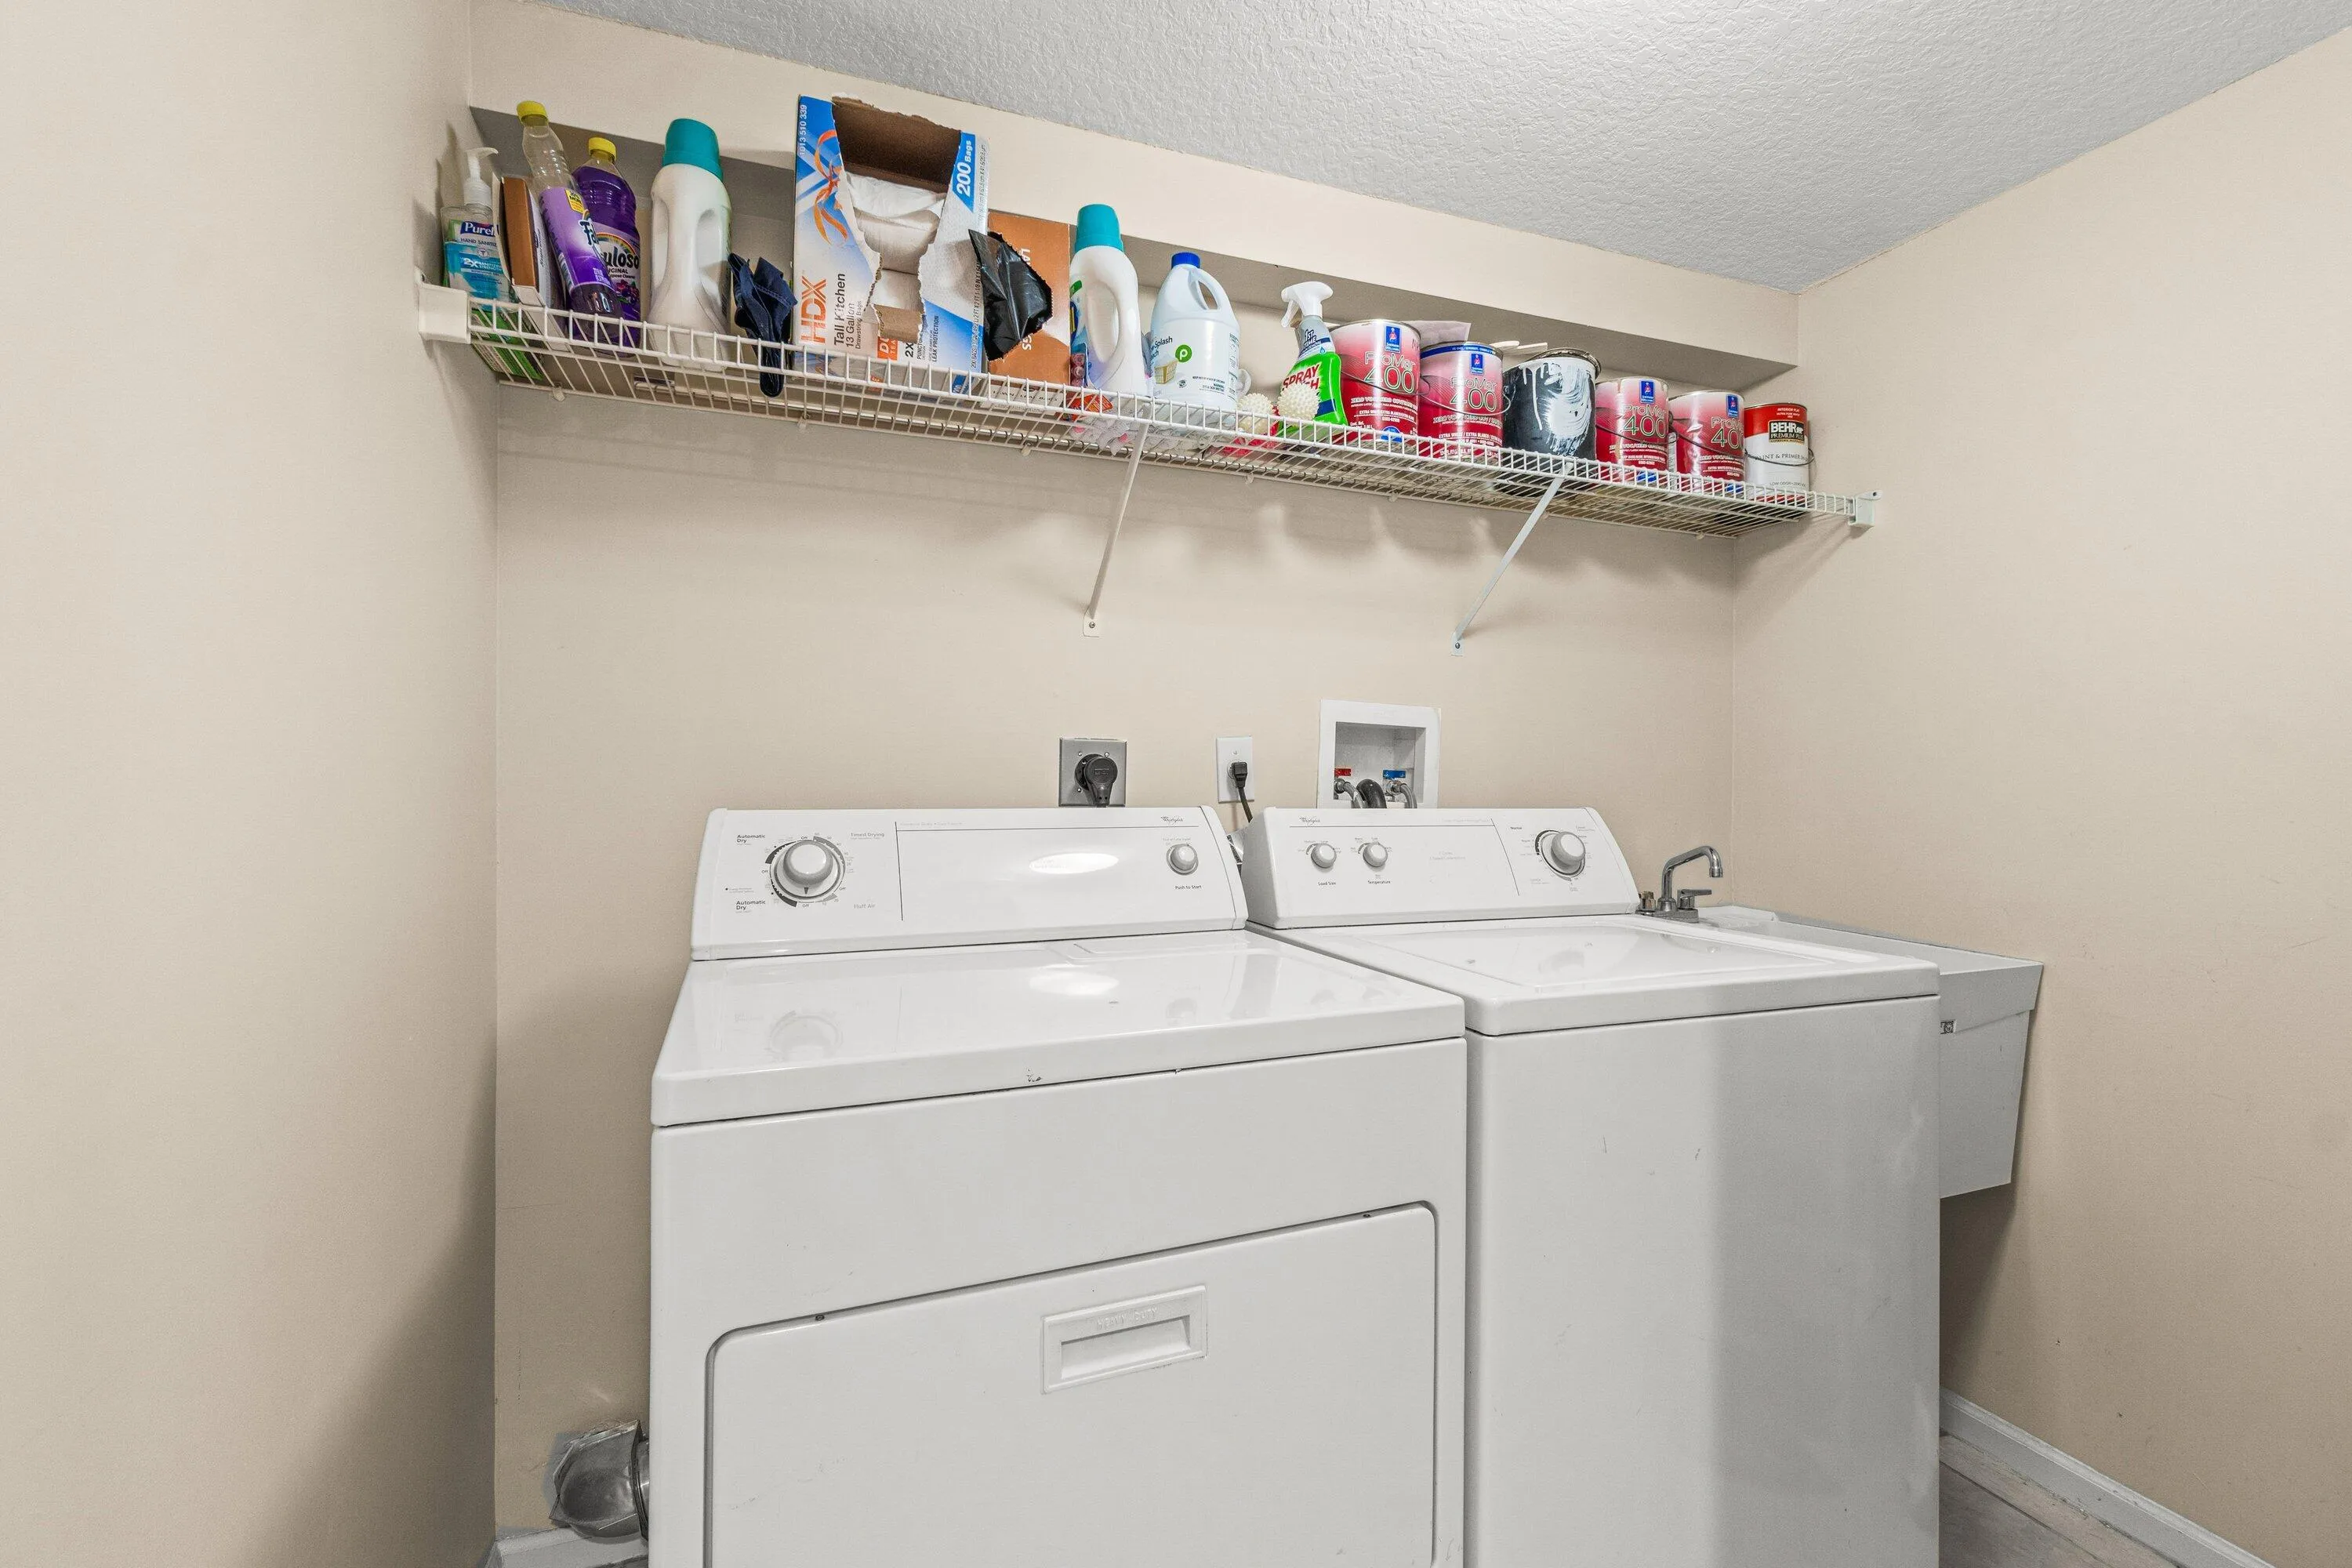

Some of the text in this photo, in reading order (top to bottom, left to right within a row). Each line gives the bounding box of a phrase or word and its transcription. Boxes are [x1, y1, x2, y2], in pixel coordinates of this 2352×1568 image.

[956, 162, 971, 197] 200
[465, 223, 493, 235] Purel
[601, 246, 639, 269] uloso
[801, 276, 826, 343] HDX
[834, 273, 845, 345] Tall Kitchen
[846, 303, 855, 347] 13 Gallon
[1155, 336, 1173, 349] Splash
[1365, 351, 1416, 372] PoMar
[1283, 364, 1319, 388] SPRAY
[1364, 365, 1414, 394] 400
[1450, 377, 1497, 392] PoMar
[1450, 389, 1497, 412] 400
[1623, 416, 1665, 439] 400
[1711, 426, 1740, 448] 40
[1770, 422, 1797, 433] BEHR
